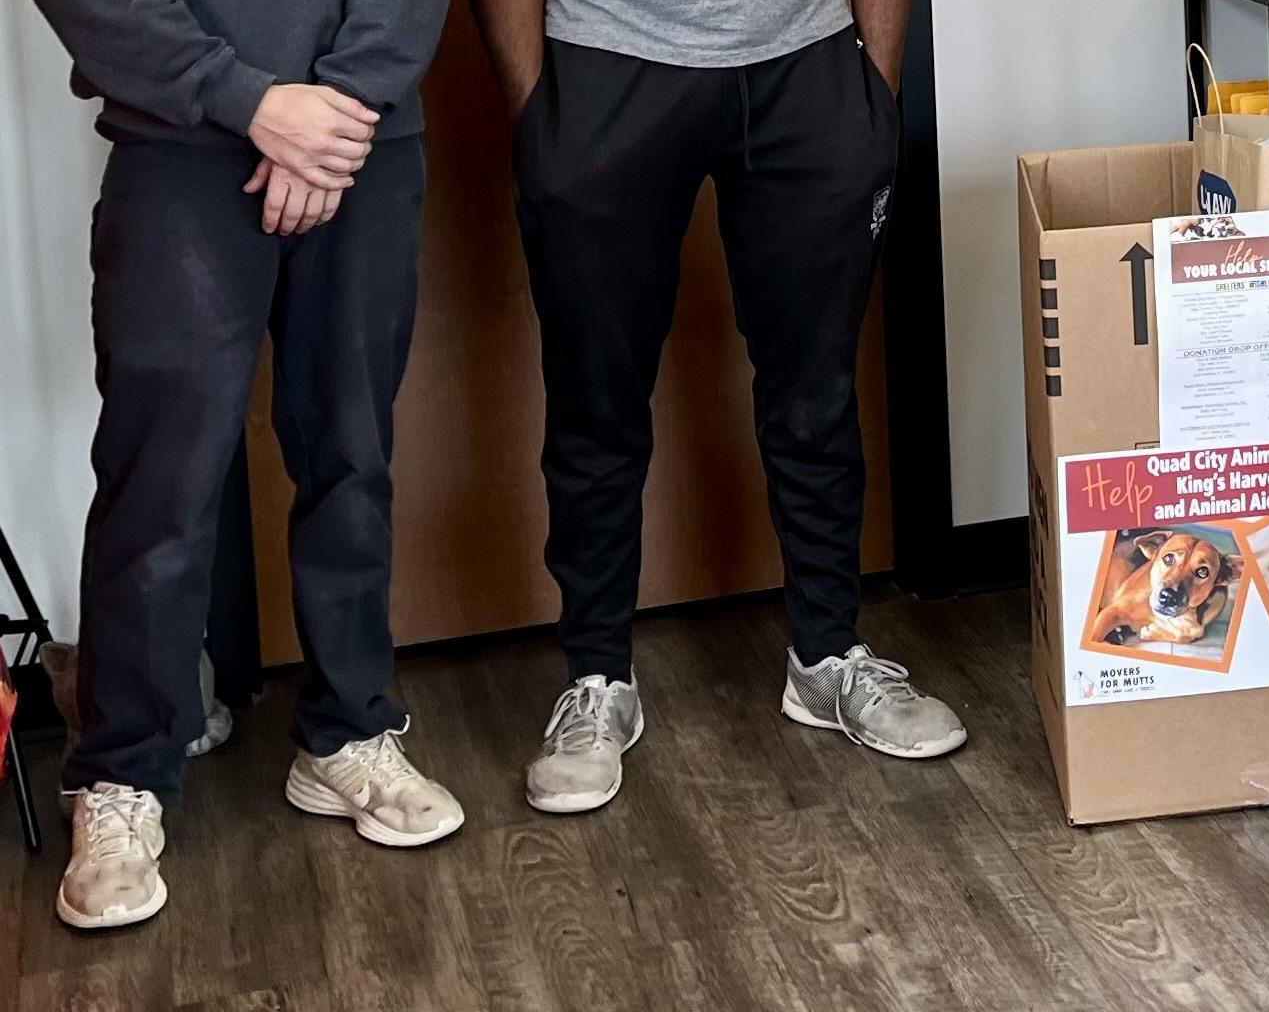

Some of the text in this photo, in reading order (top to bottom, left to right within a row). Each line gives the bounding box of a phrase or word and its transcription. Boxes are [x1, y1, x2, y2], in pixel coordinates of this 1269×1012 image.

[1224, 240, 1264, 265] Help
[1183, 264, 1217, 279] YOUR
[1221, 261, 1257, 276] LOCAL
[1183, 347, 1226, 358] DONATION
[1228, 345, 1251, 354] DROP
[1253, 343, 1268, 351] OFF
[1147, 454, 1191, 476] Quad
[1195, 450, 1227, 474] City
[1081, 460, 1154, 526] Help
[1176, 473, 1226, 498] King's
[1154, 500, 1185, 520] and
[1189, 492, 1246, 517] Animal
[1100, 667, 1141, 678] MOVERS
[1101, 676, 1154, 688] FOR MUTTS
